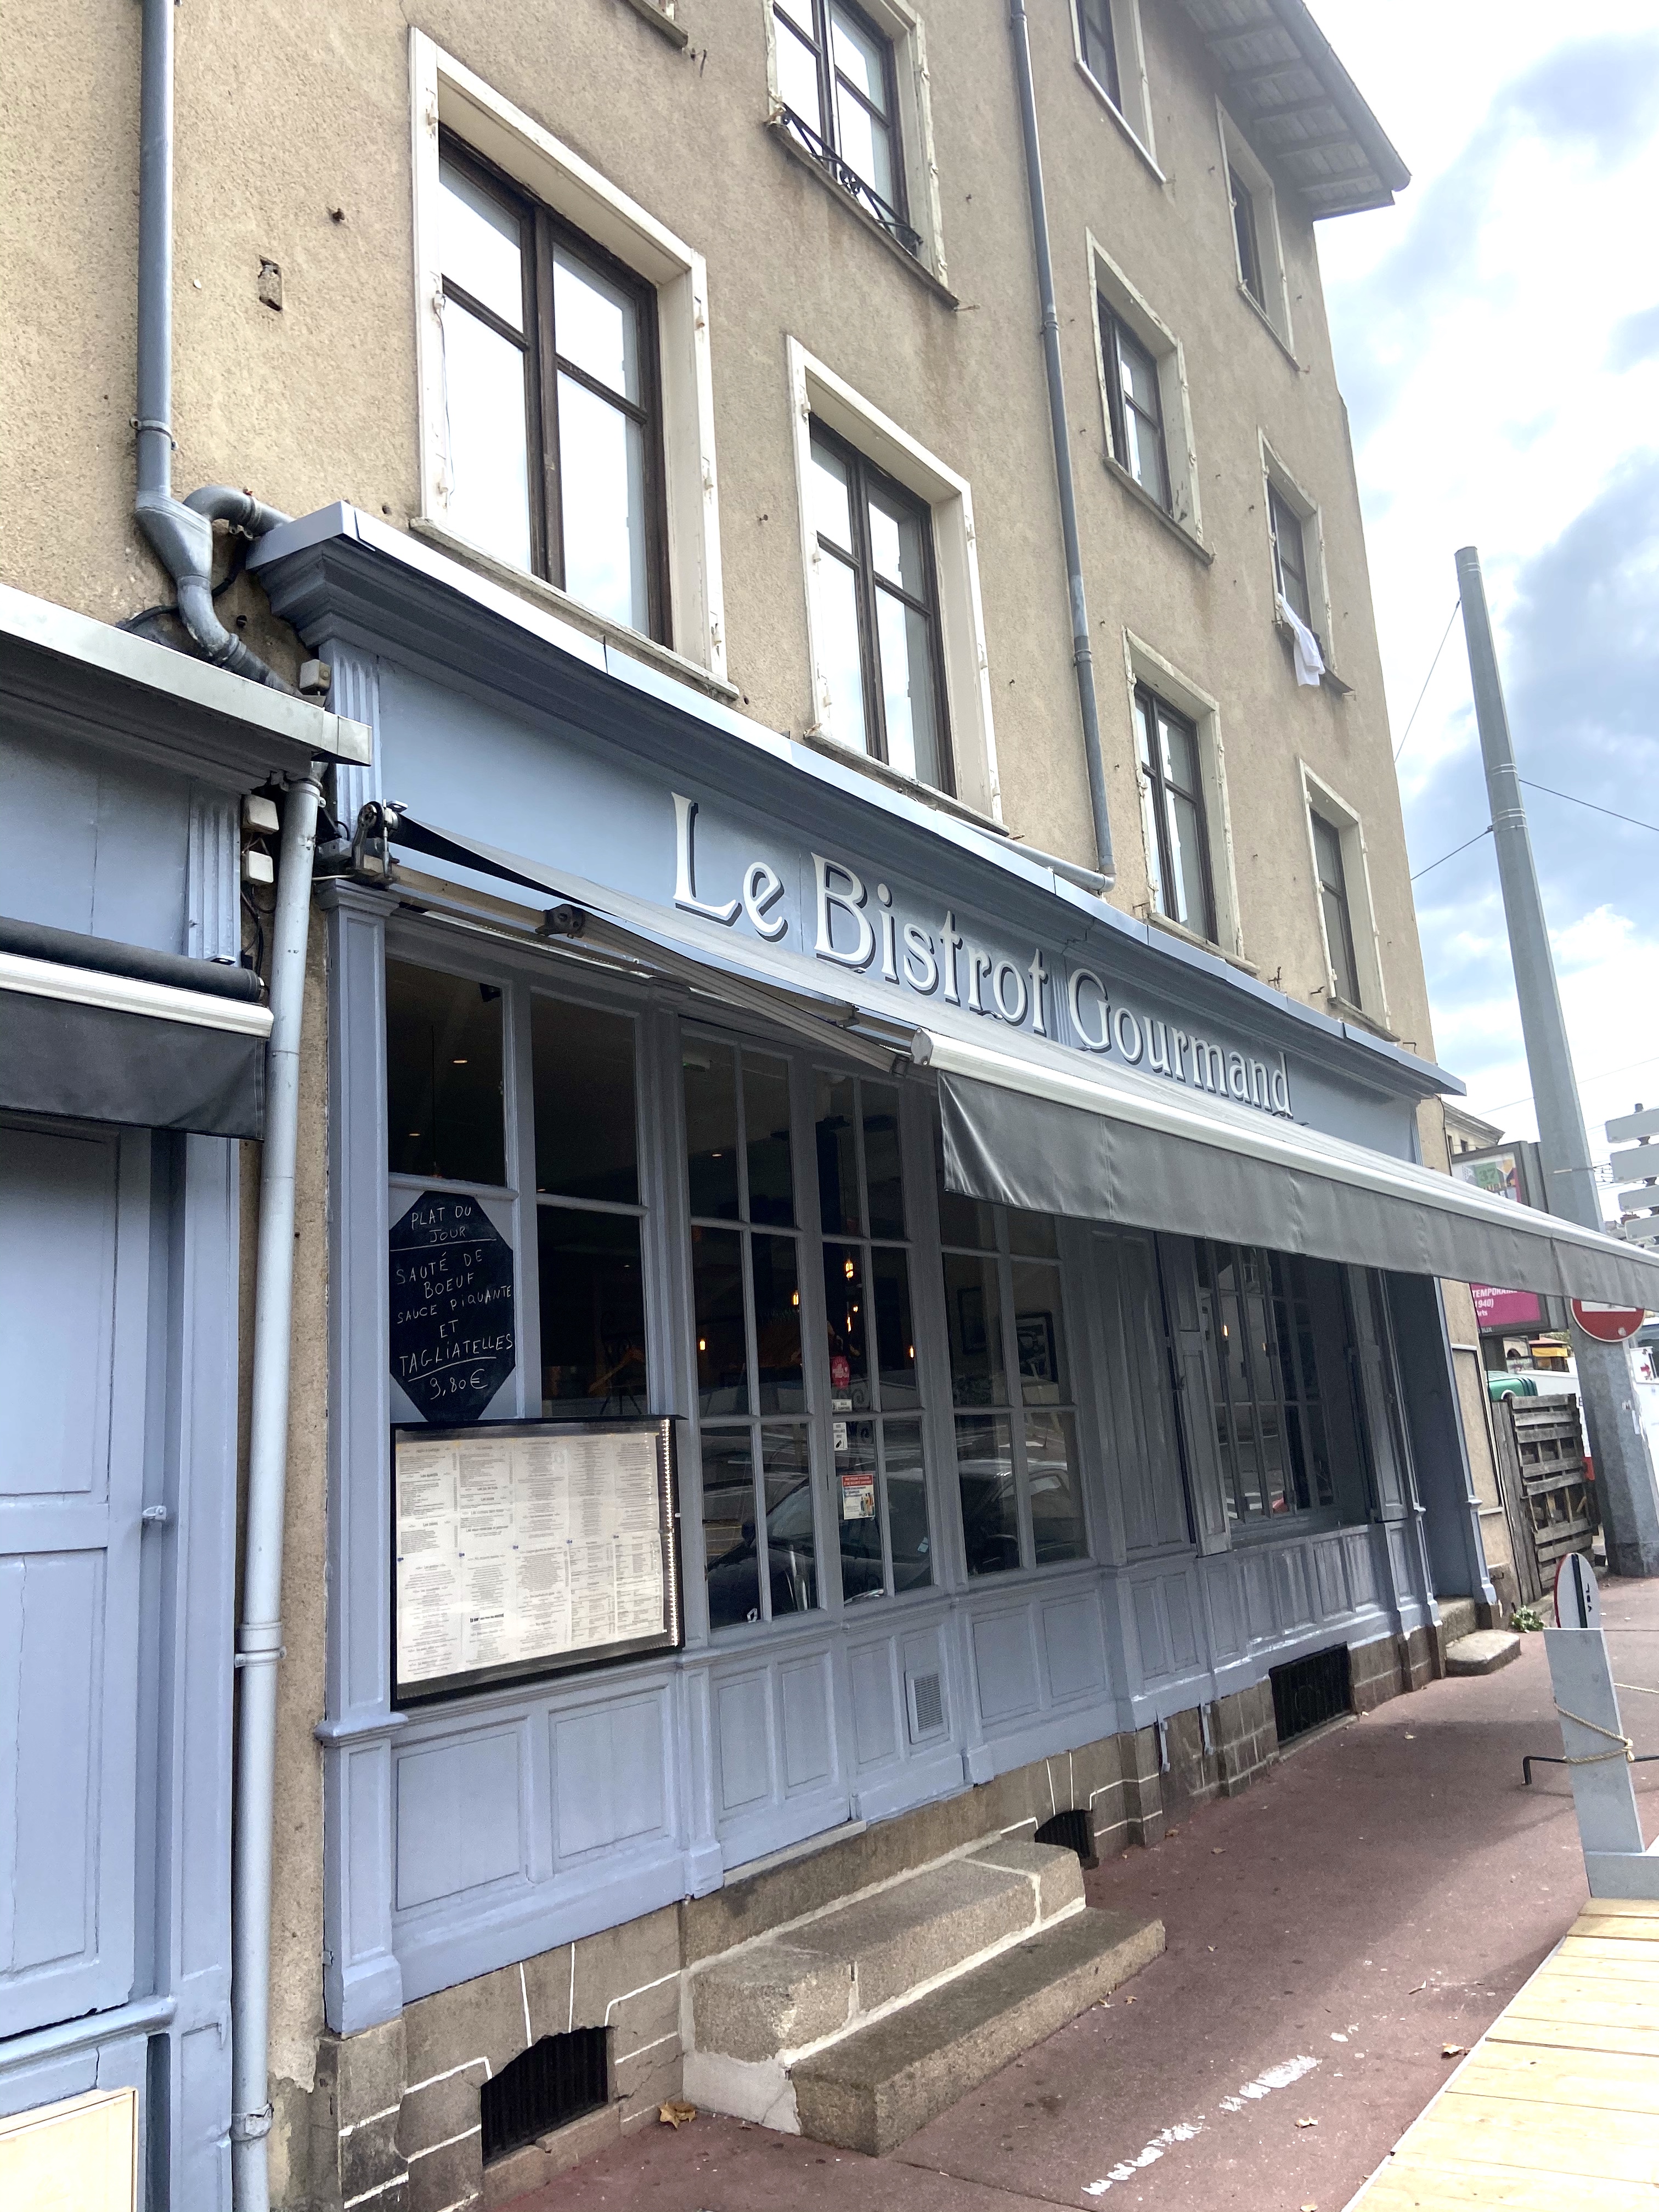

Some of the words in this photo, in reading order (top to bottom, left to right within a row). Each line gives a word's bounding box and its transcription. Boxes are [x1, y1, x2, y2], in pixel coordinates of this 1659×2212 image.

[671, 792, 787, 941] Le
[810, 851, 1049, 1036] Bistrot
[1067, 968, 1294, 1118] Gourmand
[411, 1207, 445, 1230] PLAT
[455, 1206, 471, 1218] DU
[429, 1226, 466, 1243] JOUR
[396, 1251, 449, 1285] SAUTÉ
[464, 1249, 482, 1267] DE
[424, 1272, 475, 1299] BOEUF
[397, 1304, 437, 1324] SAUCE
[439, 1319, 459, 1338] ET
[430, 1369, 488, 1400] 9,80€
